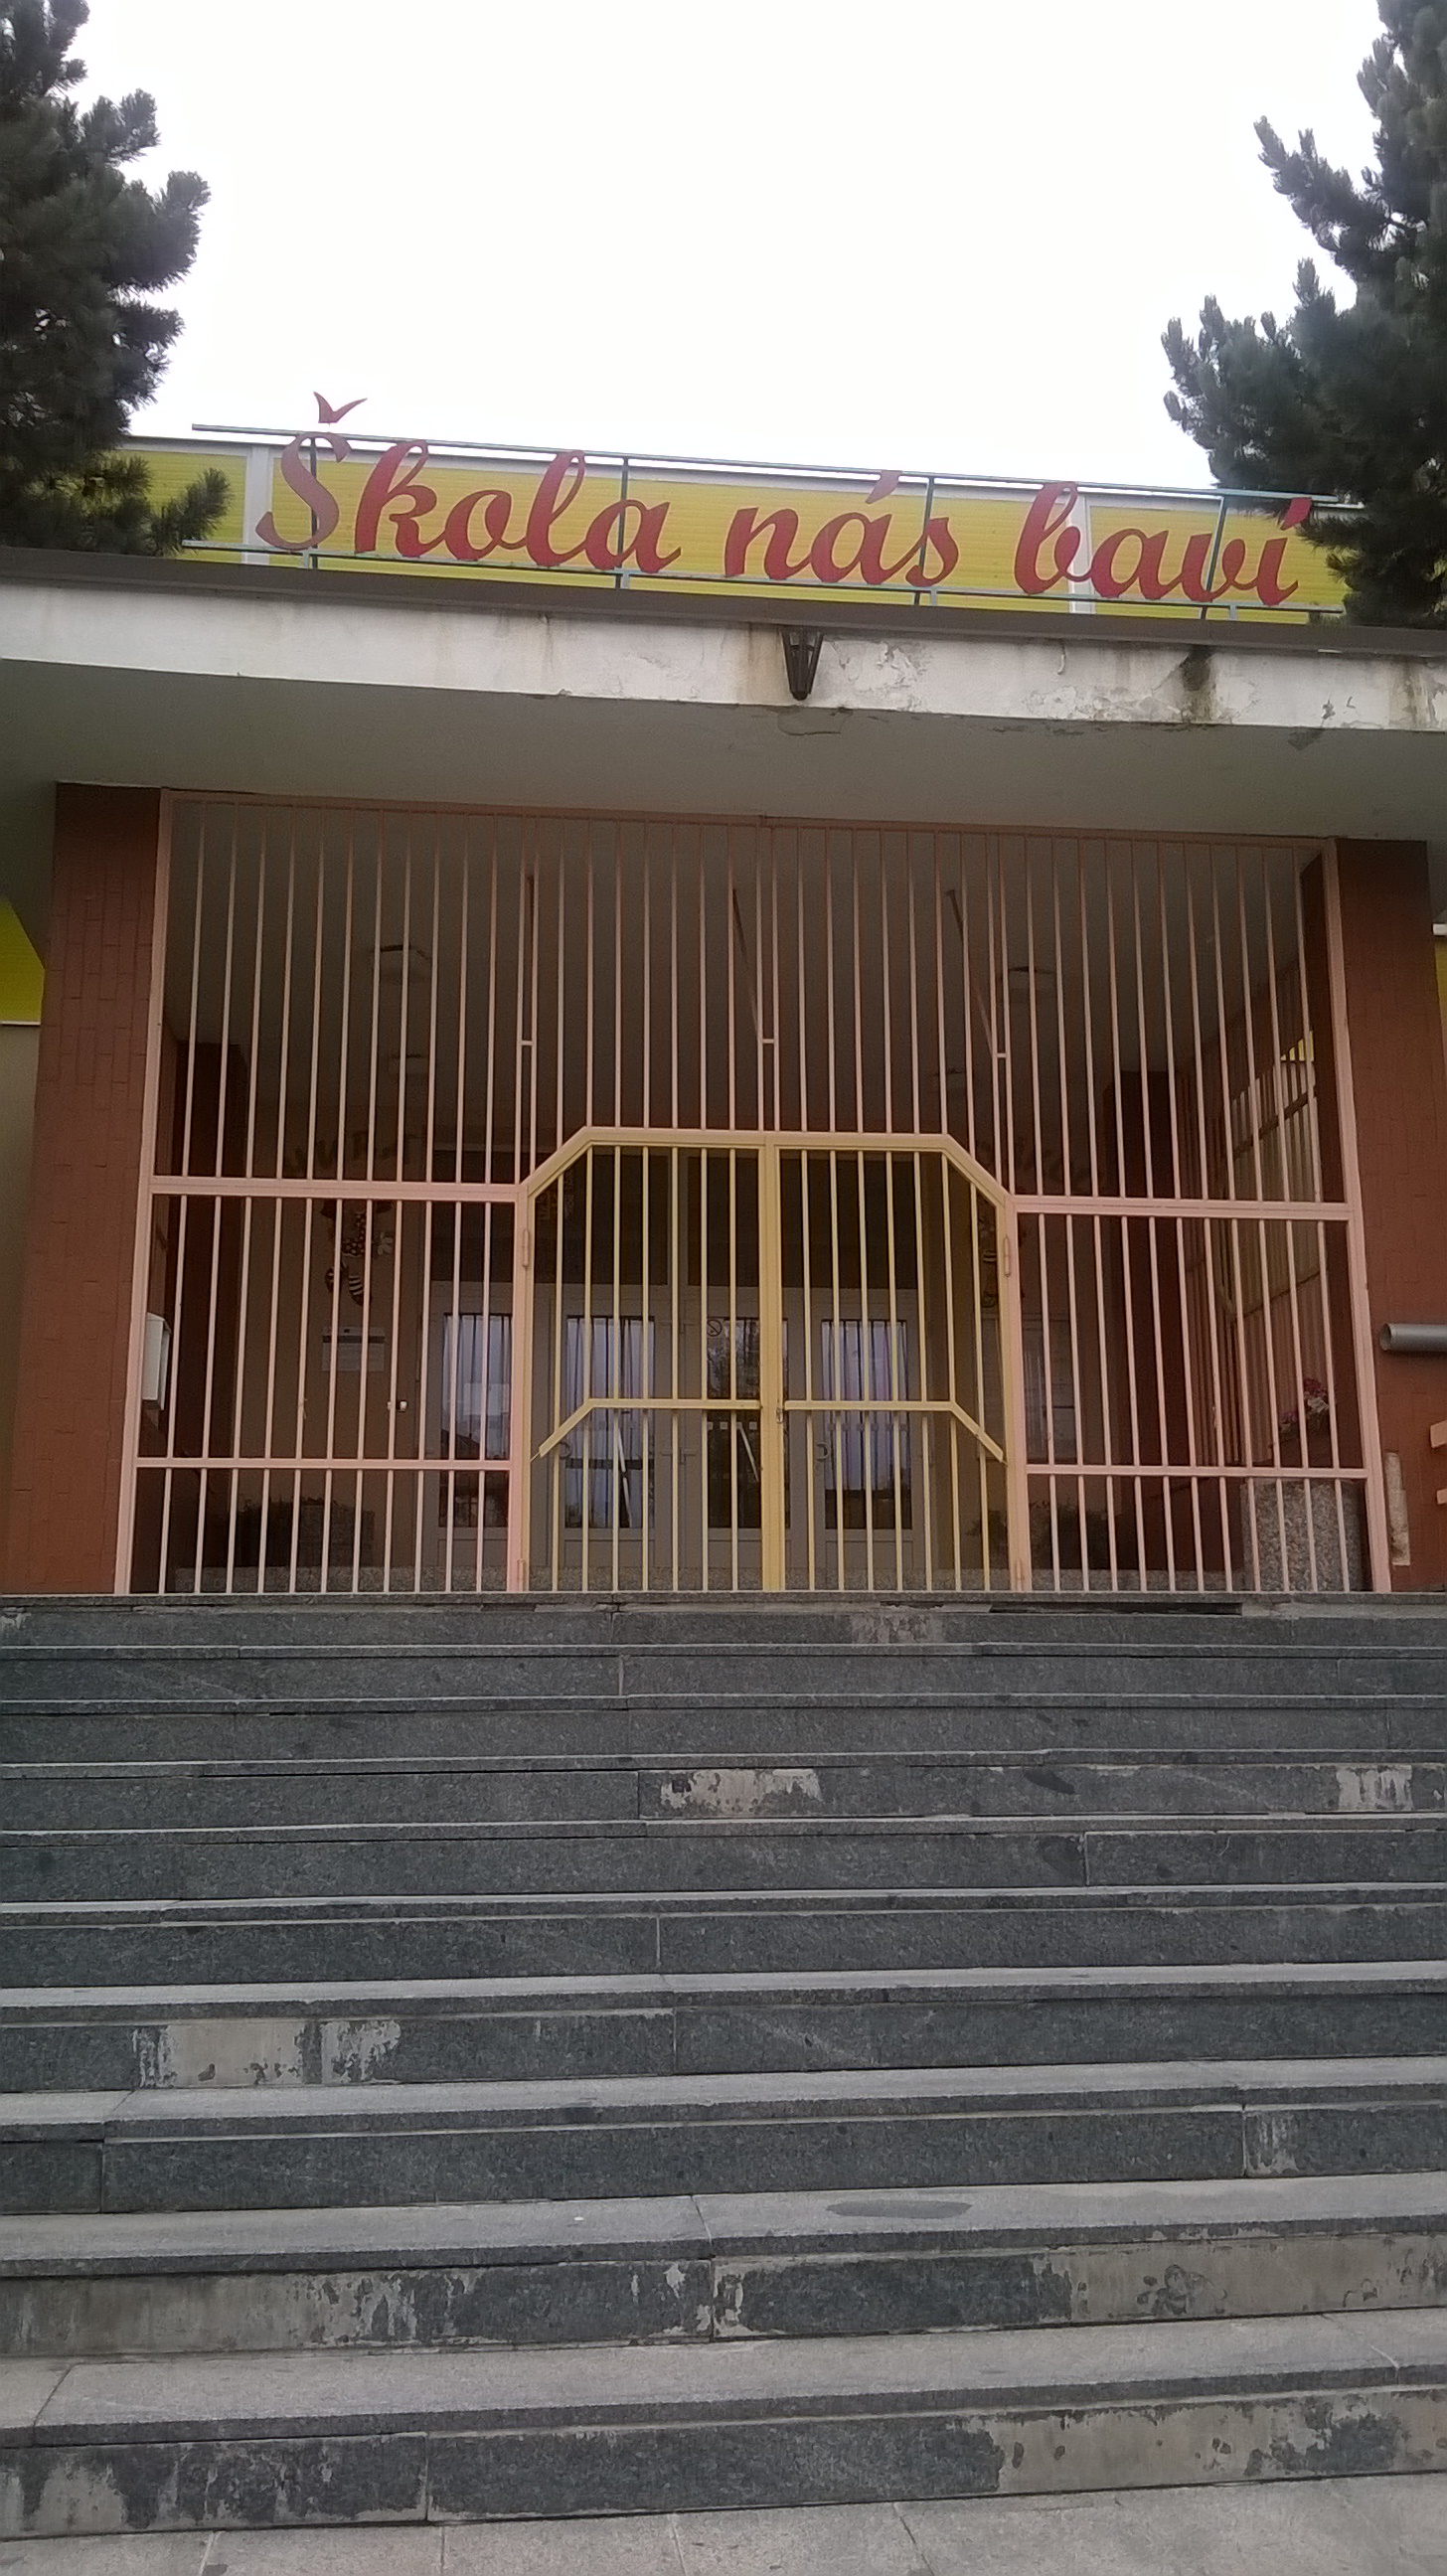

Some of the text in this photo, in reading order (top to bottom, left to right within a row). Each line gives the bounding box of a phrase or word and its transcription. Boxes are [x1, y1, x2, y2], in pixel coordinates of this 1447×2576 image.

[255, 392, 1313, 606] Škola nás baví
